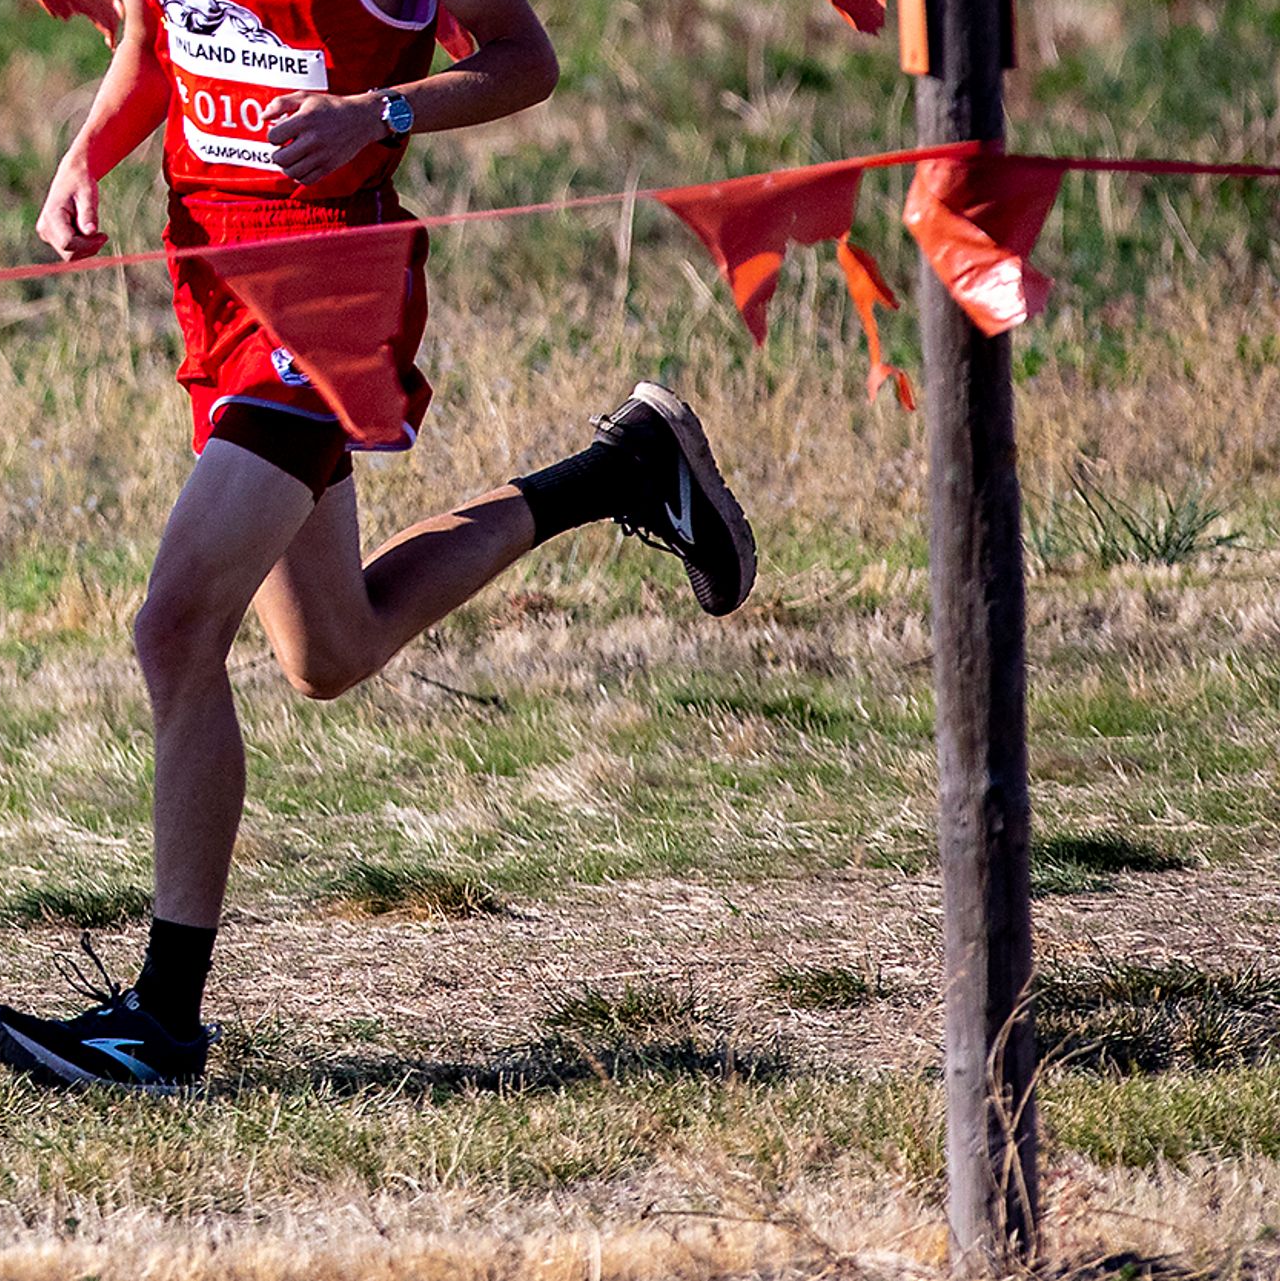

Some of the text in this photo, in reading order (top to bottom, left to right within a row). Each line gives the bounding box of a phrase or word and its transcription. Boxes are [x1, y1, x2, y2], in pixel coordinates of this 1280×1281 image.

[176, 36, 309, 74] INLAND EMPIRE
[194, 90, 288, 132] 010
